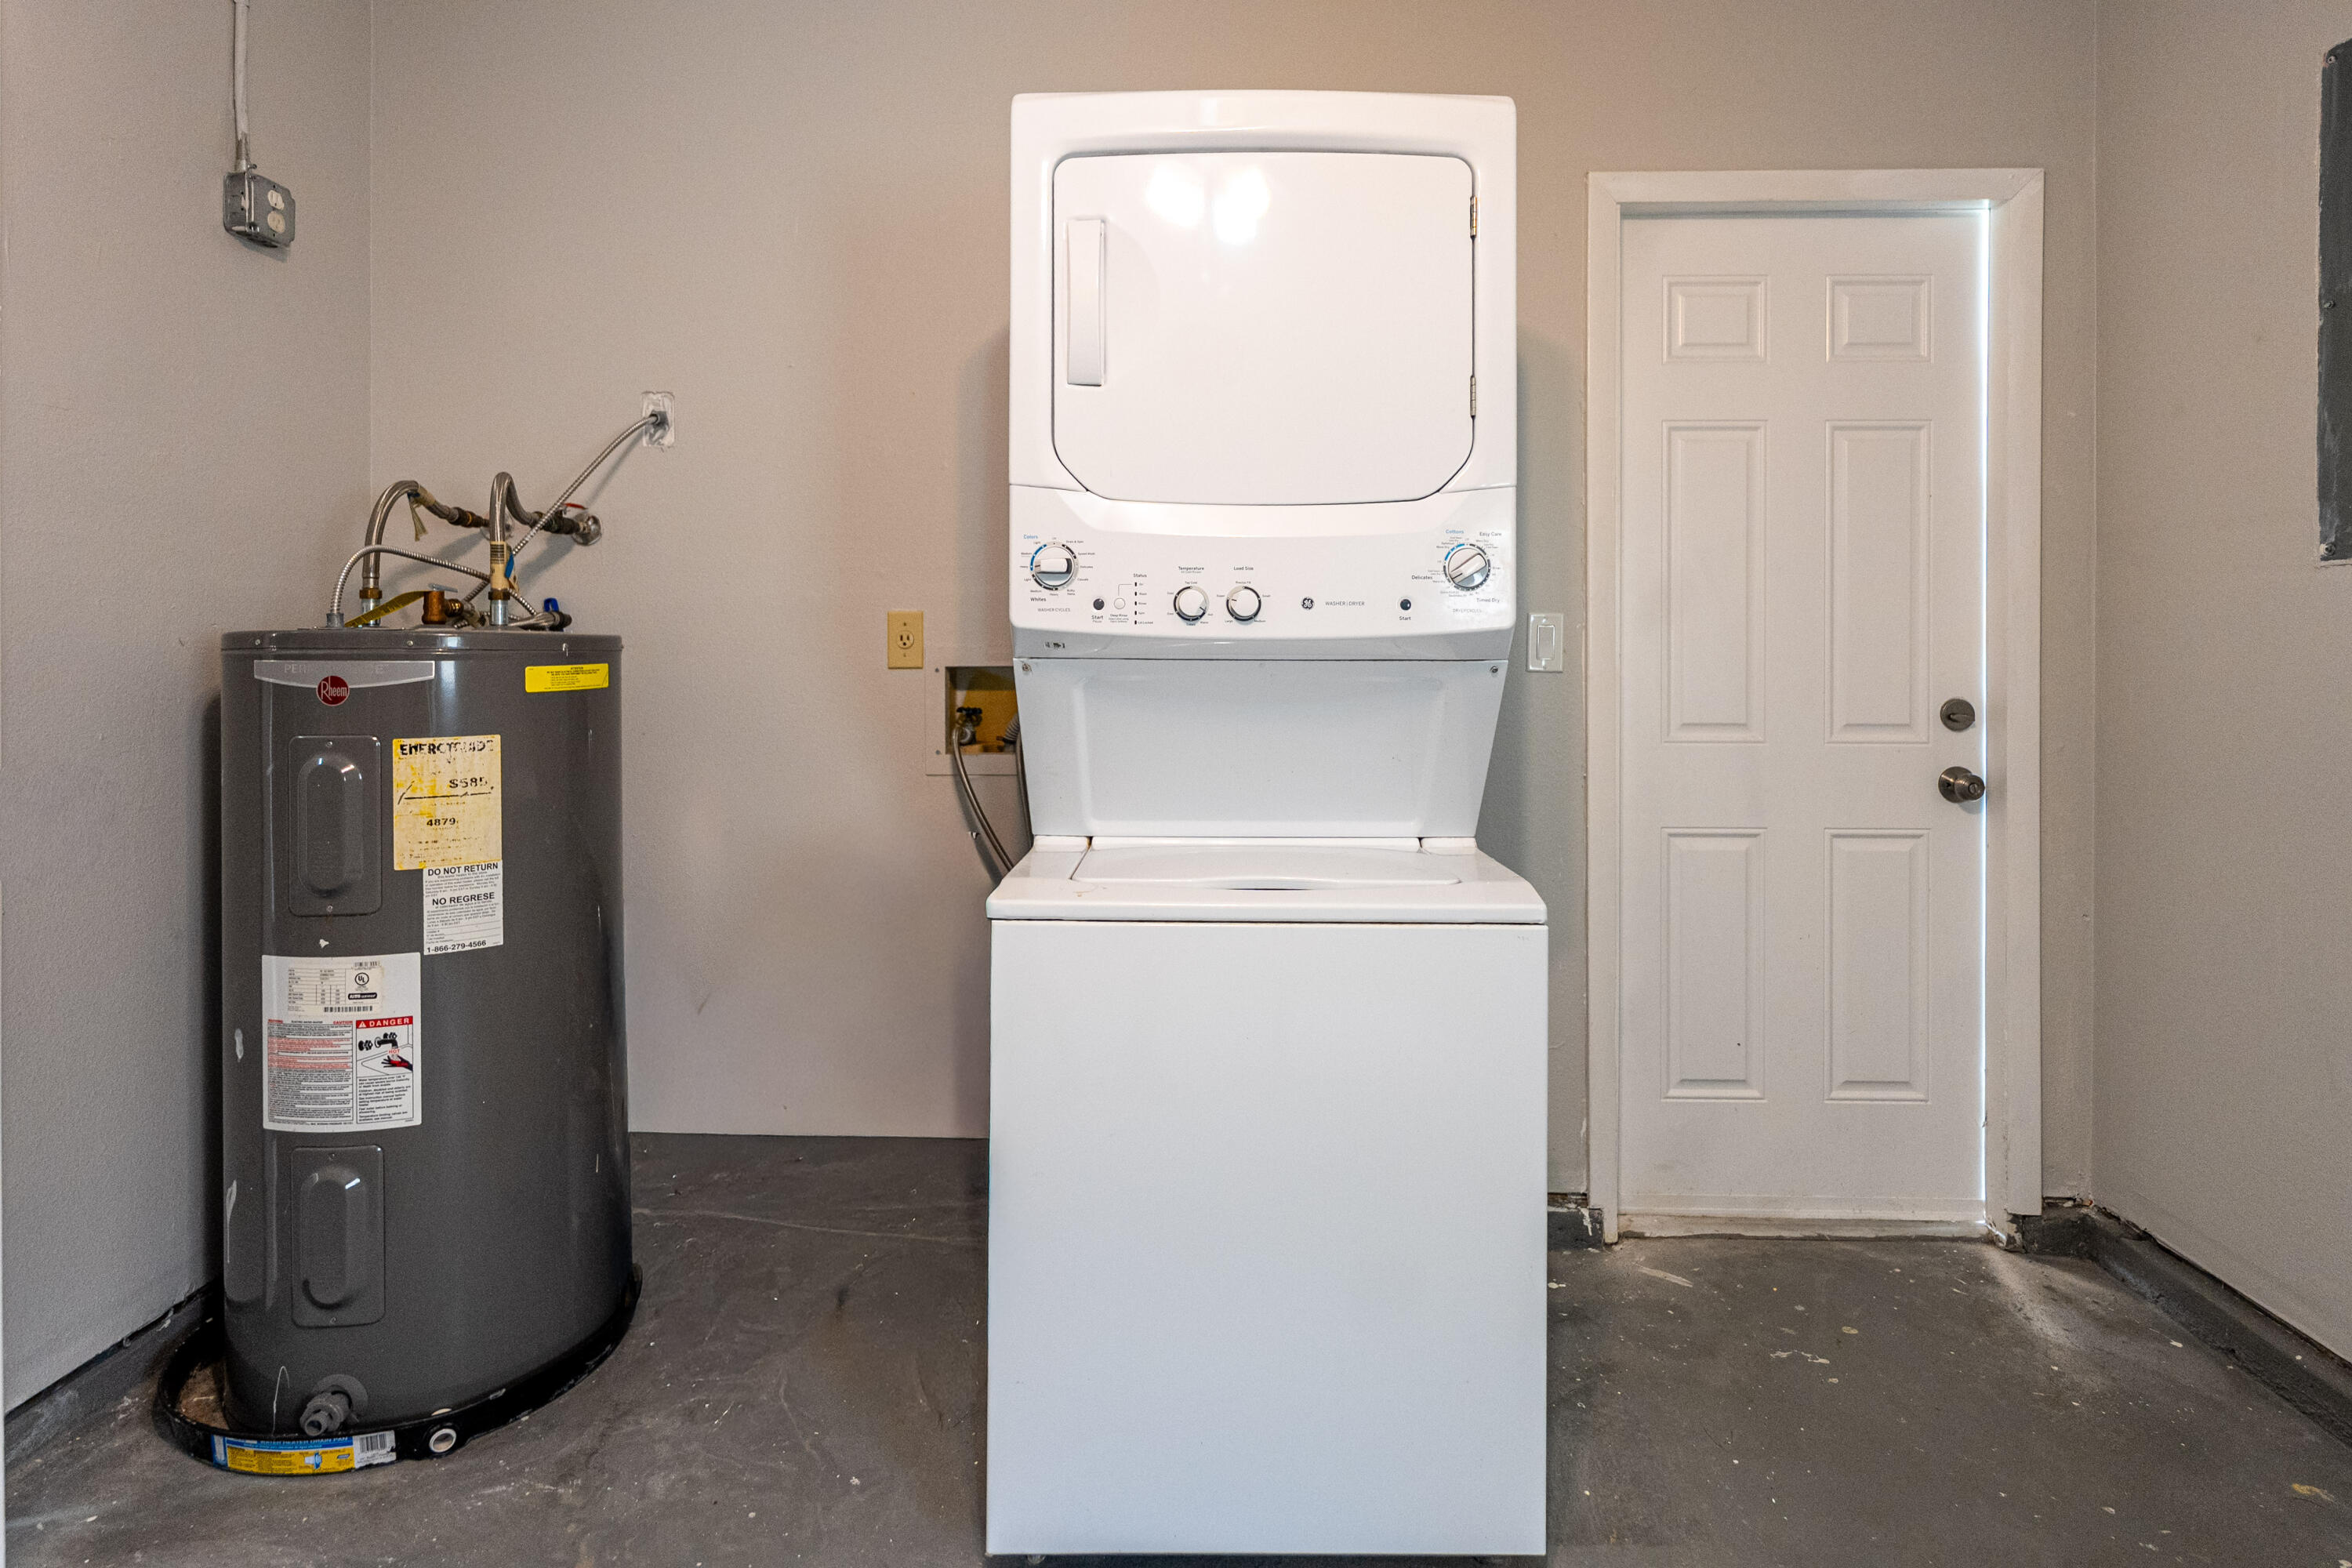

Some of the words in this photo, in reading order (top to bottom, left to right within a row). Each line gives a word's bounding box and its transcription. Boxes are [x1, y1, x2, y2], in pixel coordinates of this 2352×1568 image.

[320, 676, 347, 700] Rheem
[426, 817, 456, 826] 4879
[444, 866, 462, 875] NOT
[464, 862, 499, 873] RETURN
[432, 897, 447, 906] NO
[449, 892, 495, 904] REGRESE
[426, 940, 487, 953] 1-866-279-4566
[368, 1018, 410, 1027] DANGER
